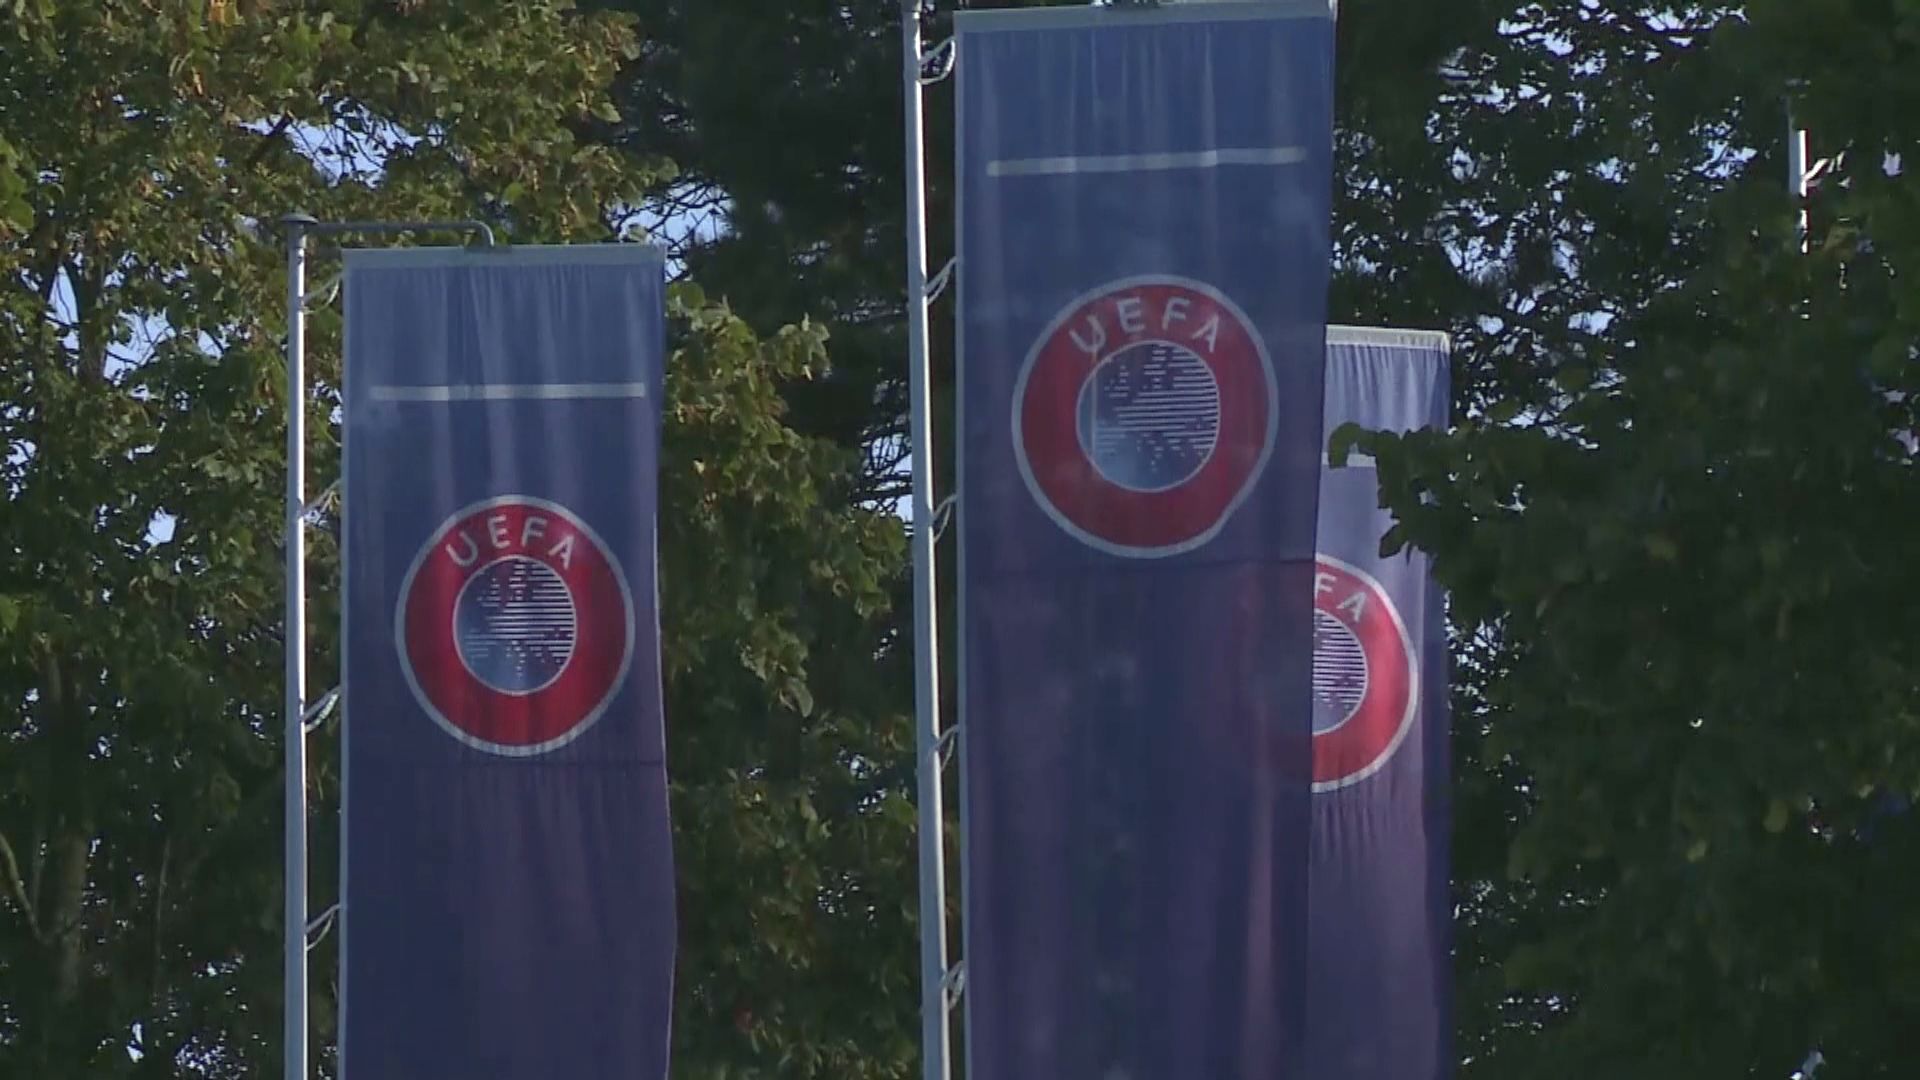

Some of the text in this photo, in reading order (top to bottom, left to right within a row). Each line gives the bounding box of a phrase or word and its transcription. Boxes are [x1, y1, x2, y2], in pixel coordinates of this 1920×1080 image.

[1069, 296, 1220, 354] UEFA
[445, 514, 575, 570] UEFA
[1314, 572, 1367, 623] FA
